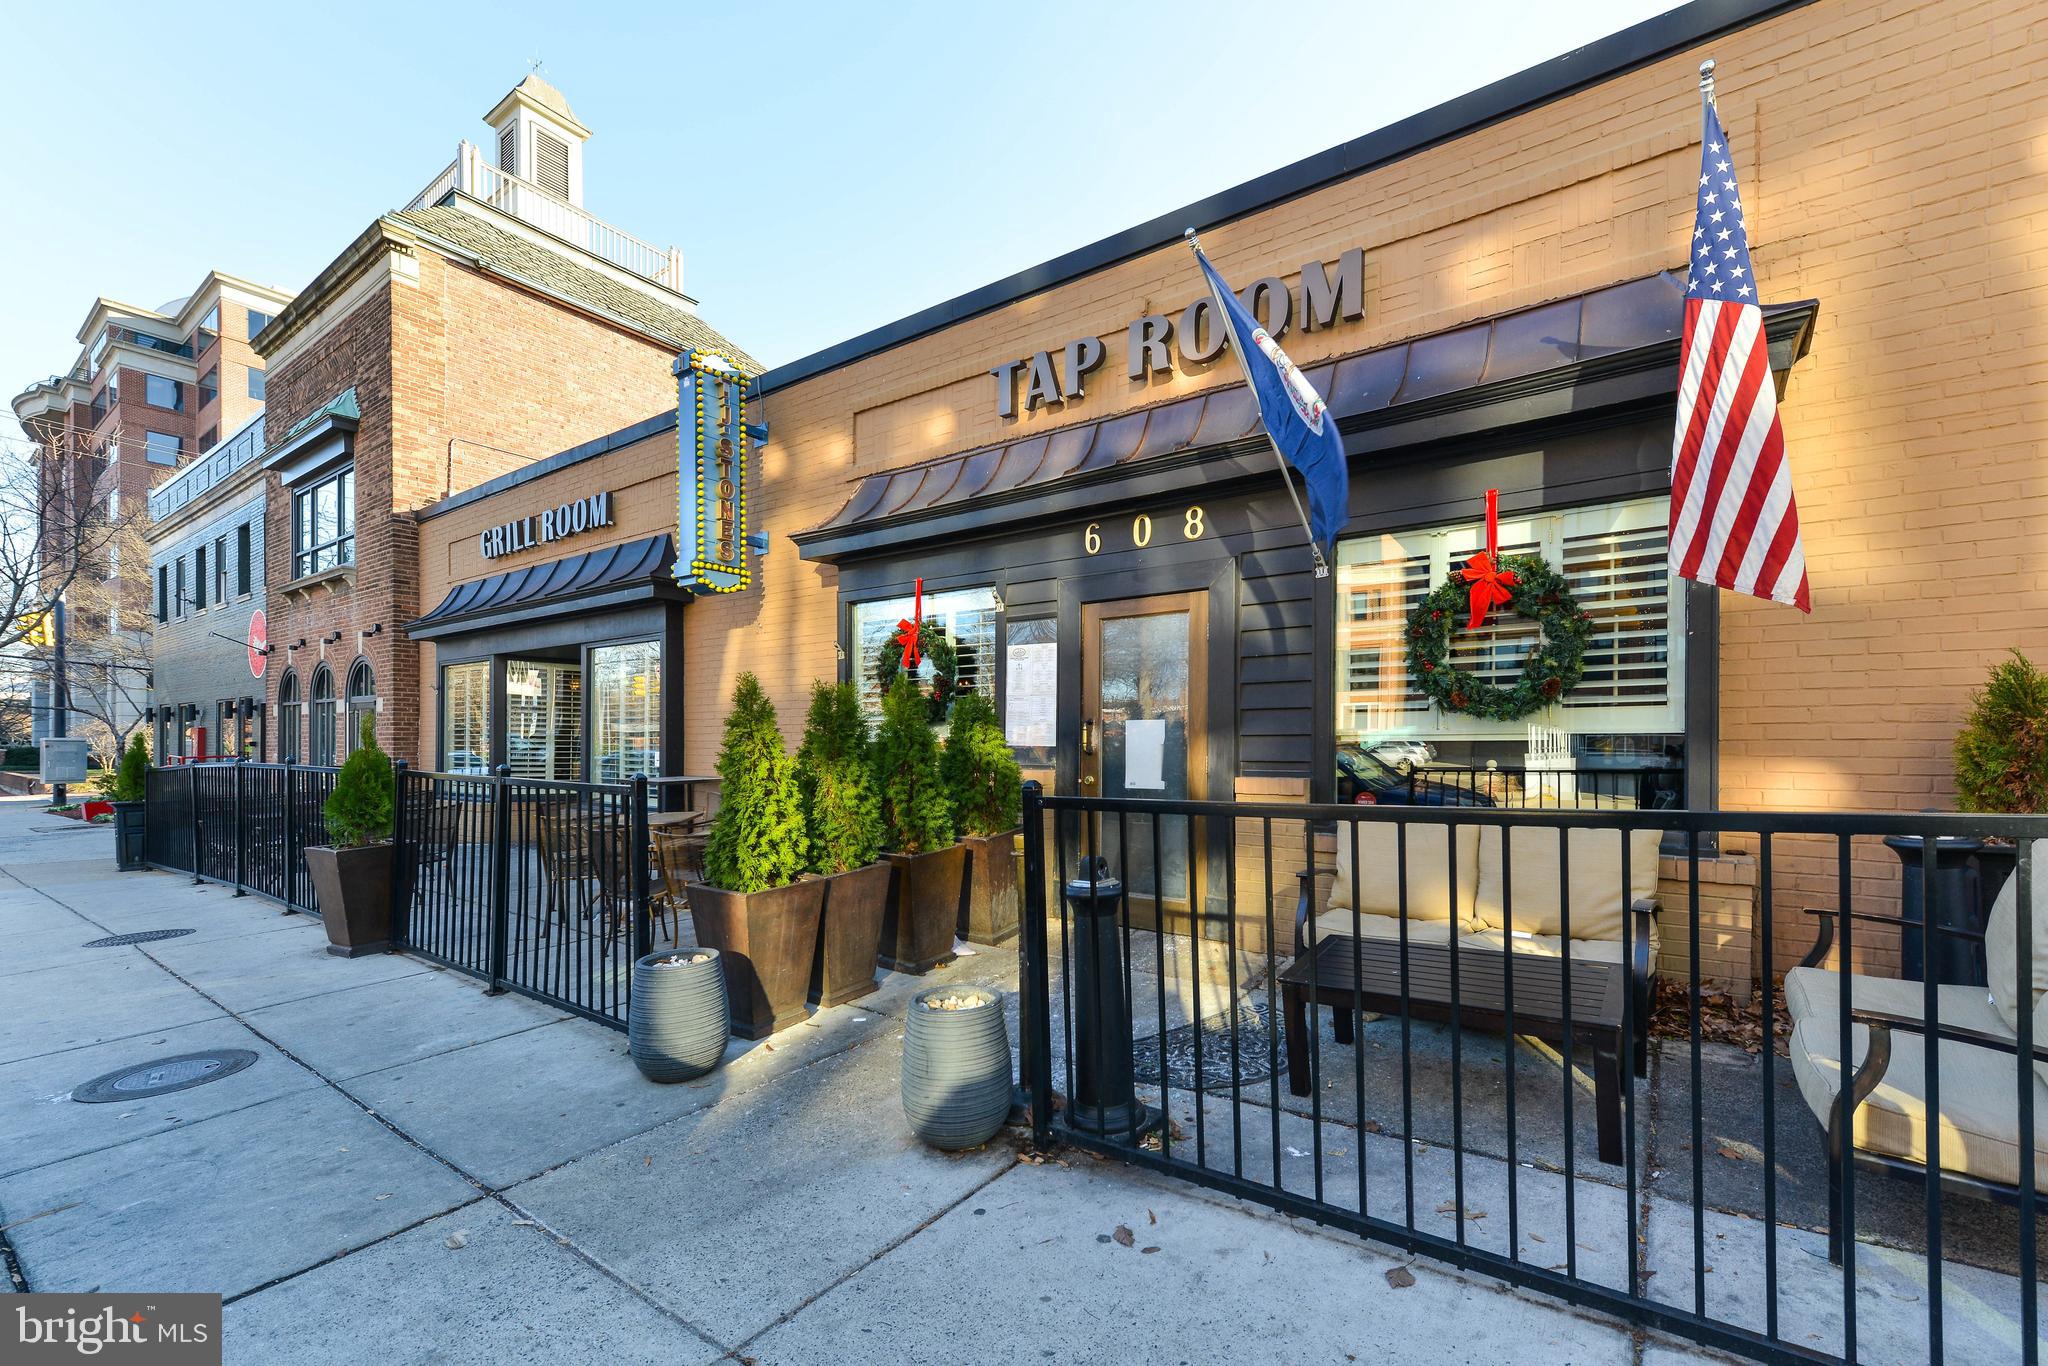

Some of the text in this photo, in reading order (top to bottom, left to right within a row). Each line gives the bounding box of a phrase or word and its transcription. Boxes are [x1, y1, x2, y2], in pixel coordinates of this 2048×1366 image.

[990, 247, 1365, 419] TAP ROOM
[480, 491, 613, 559] GRILL ROOM
[715, 438, 736, 561] STONES
